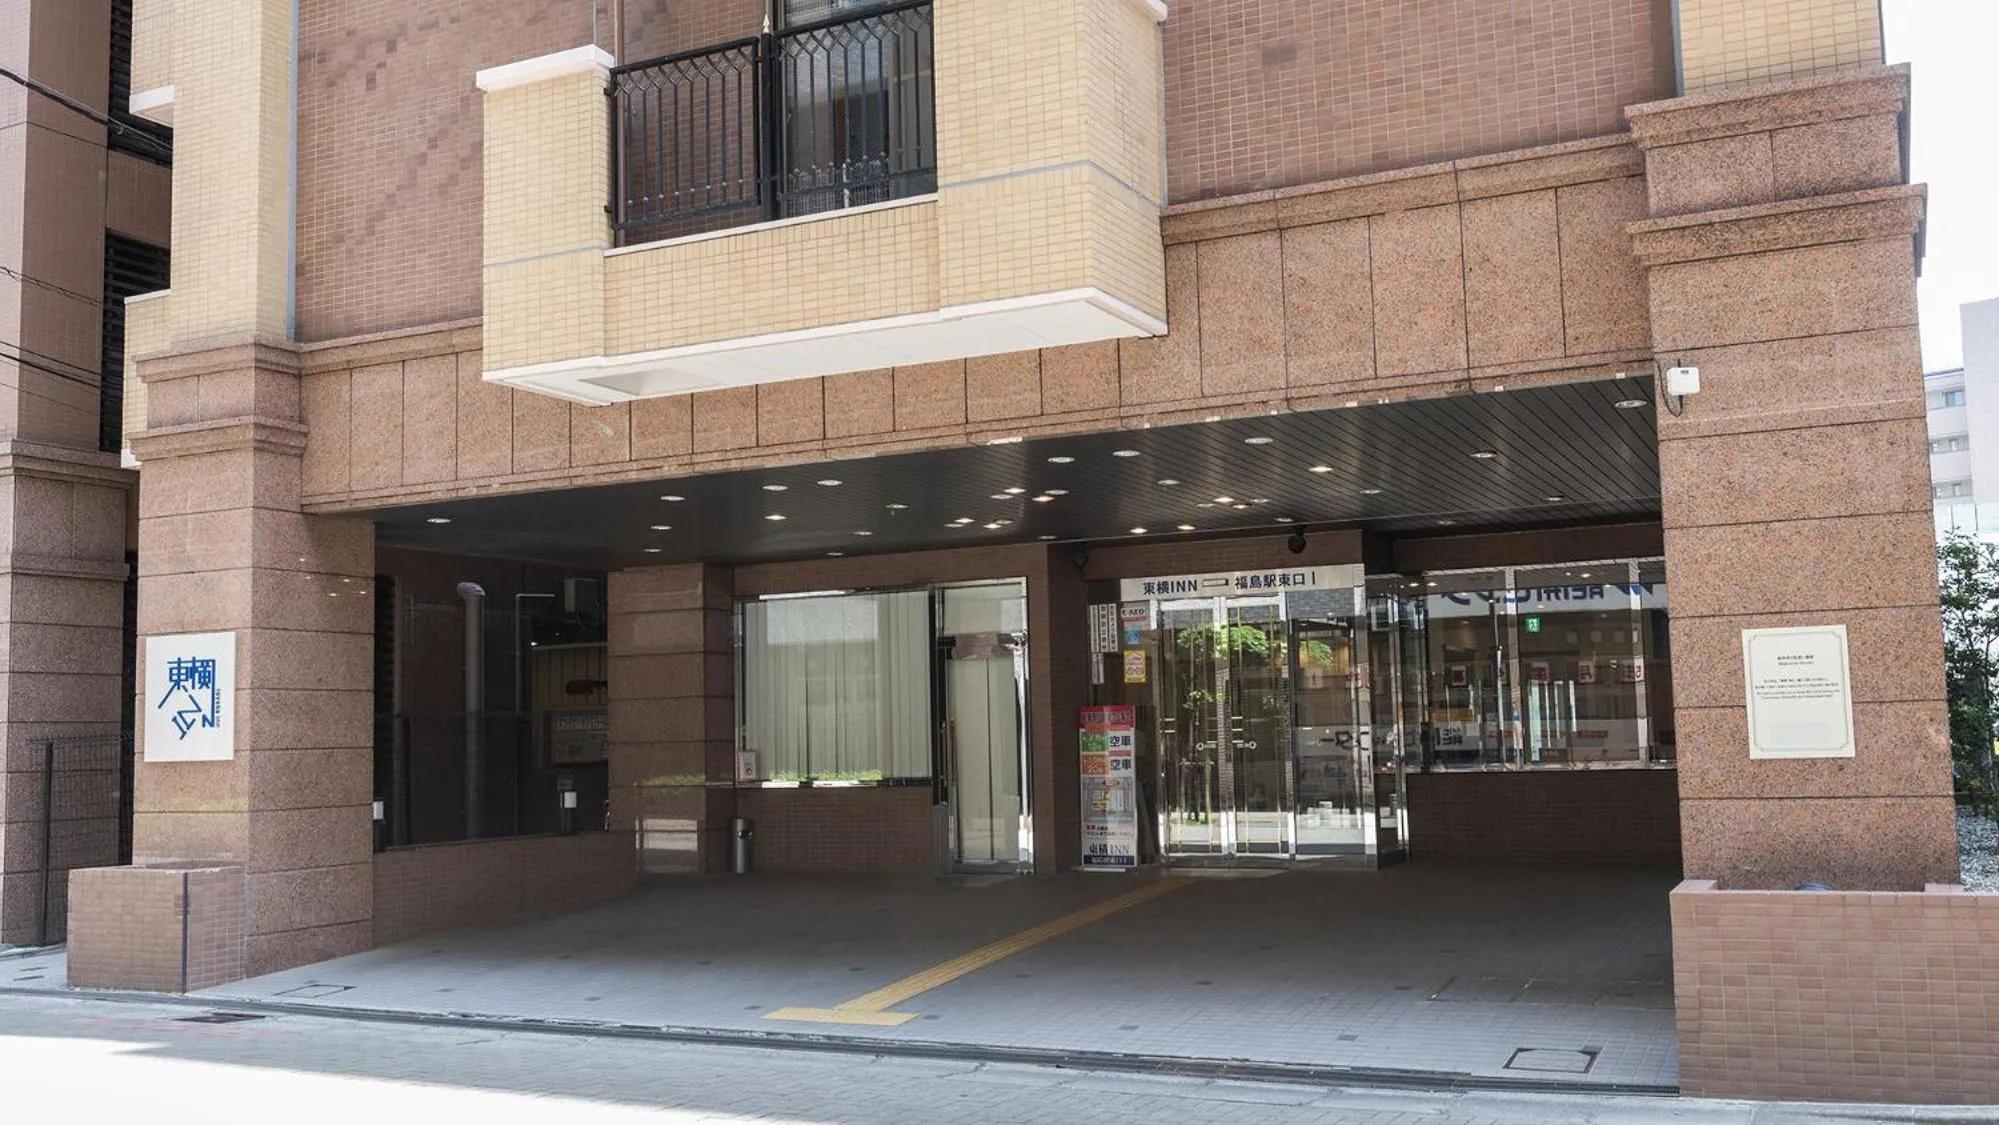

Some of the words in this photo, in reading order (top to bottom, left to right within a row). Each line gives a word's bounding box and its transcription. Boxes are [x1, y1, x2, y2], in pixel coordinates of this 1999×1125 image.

[1142, 579, 1198, 595] 東横INN
[1109, 735, 1131, 747] 空車
[1110, 759, 1132, 771] 空車
